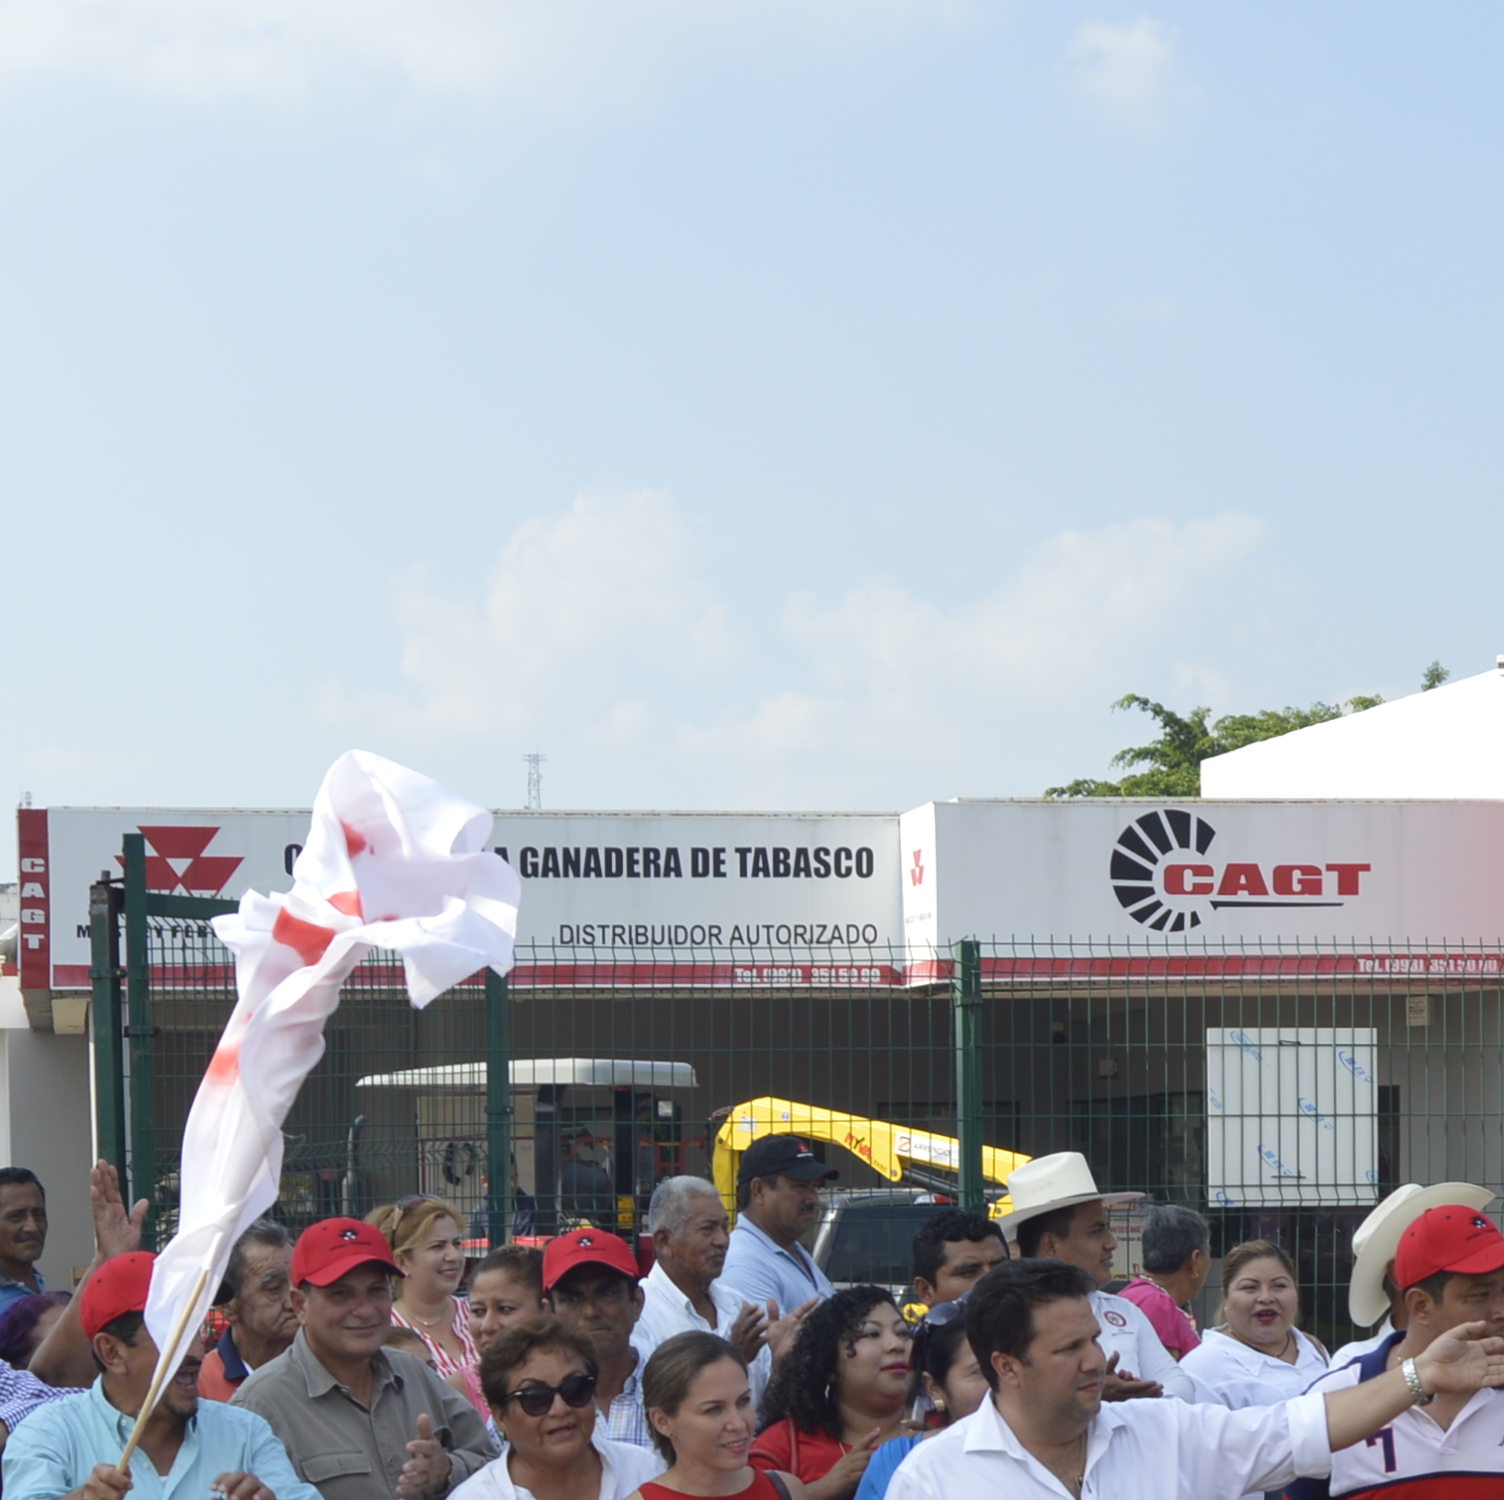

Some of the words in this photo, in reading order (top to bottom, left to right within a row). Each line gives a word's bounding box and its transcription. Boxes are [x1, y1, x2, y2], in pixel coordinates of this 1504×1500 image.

[519, 847, 683, 879] GANADERA
[691, 847, 727, 878] DE
[735, 847, 875, 879] TABASCO
[1163, 862, 1372, 897] CAGT
[21, 857, 46, 950] CAGT
[559, 923, 723, 946] DISTRIBUIDOR
[729, 923, 878, 945] AUTORIZADO
